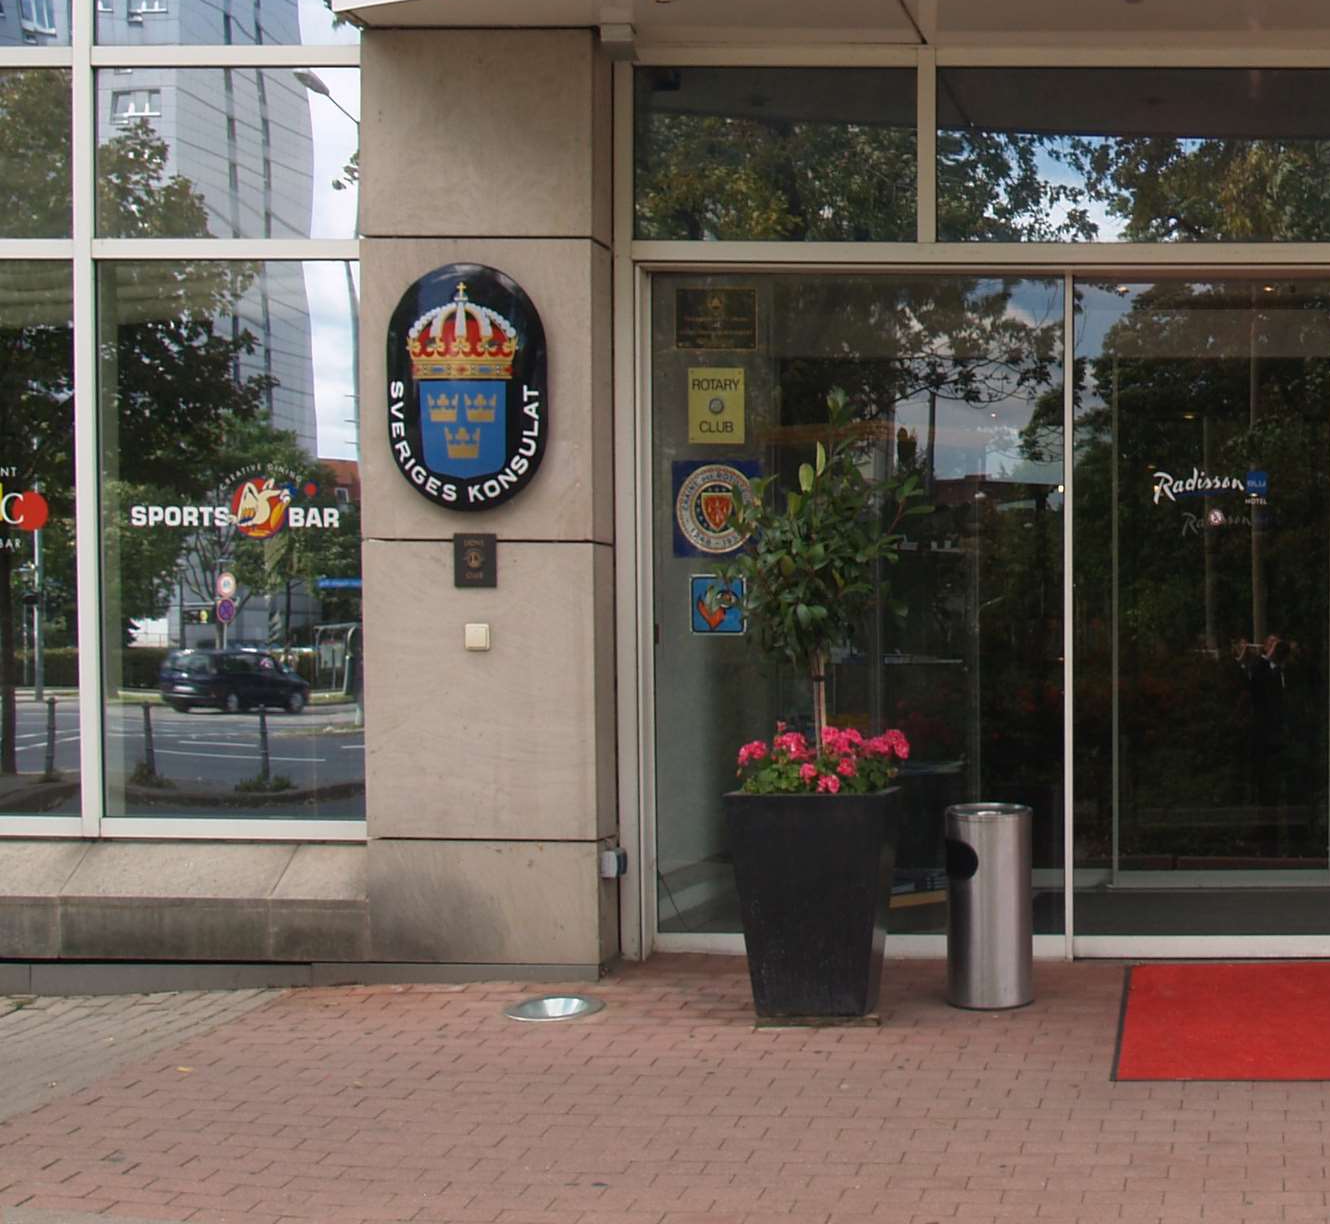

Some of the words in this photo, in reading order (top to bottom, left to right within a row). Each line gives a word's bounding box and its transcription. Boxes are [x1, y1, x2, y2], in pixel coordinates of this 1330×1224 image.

[692, 378, 741, 391] ROTARY
[699, 420, 734, 433] CLUB
[390, 380, 457, 502] SVERIGES
[468, 384, 540, 503] KONSULAT
[1153, 466, 1245, 505] Radisson
[1245, 497, 1268, 505] HOTEL
[131, 505, 230, 527] SPORTS
[288, 506, 340, 528] BAR
